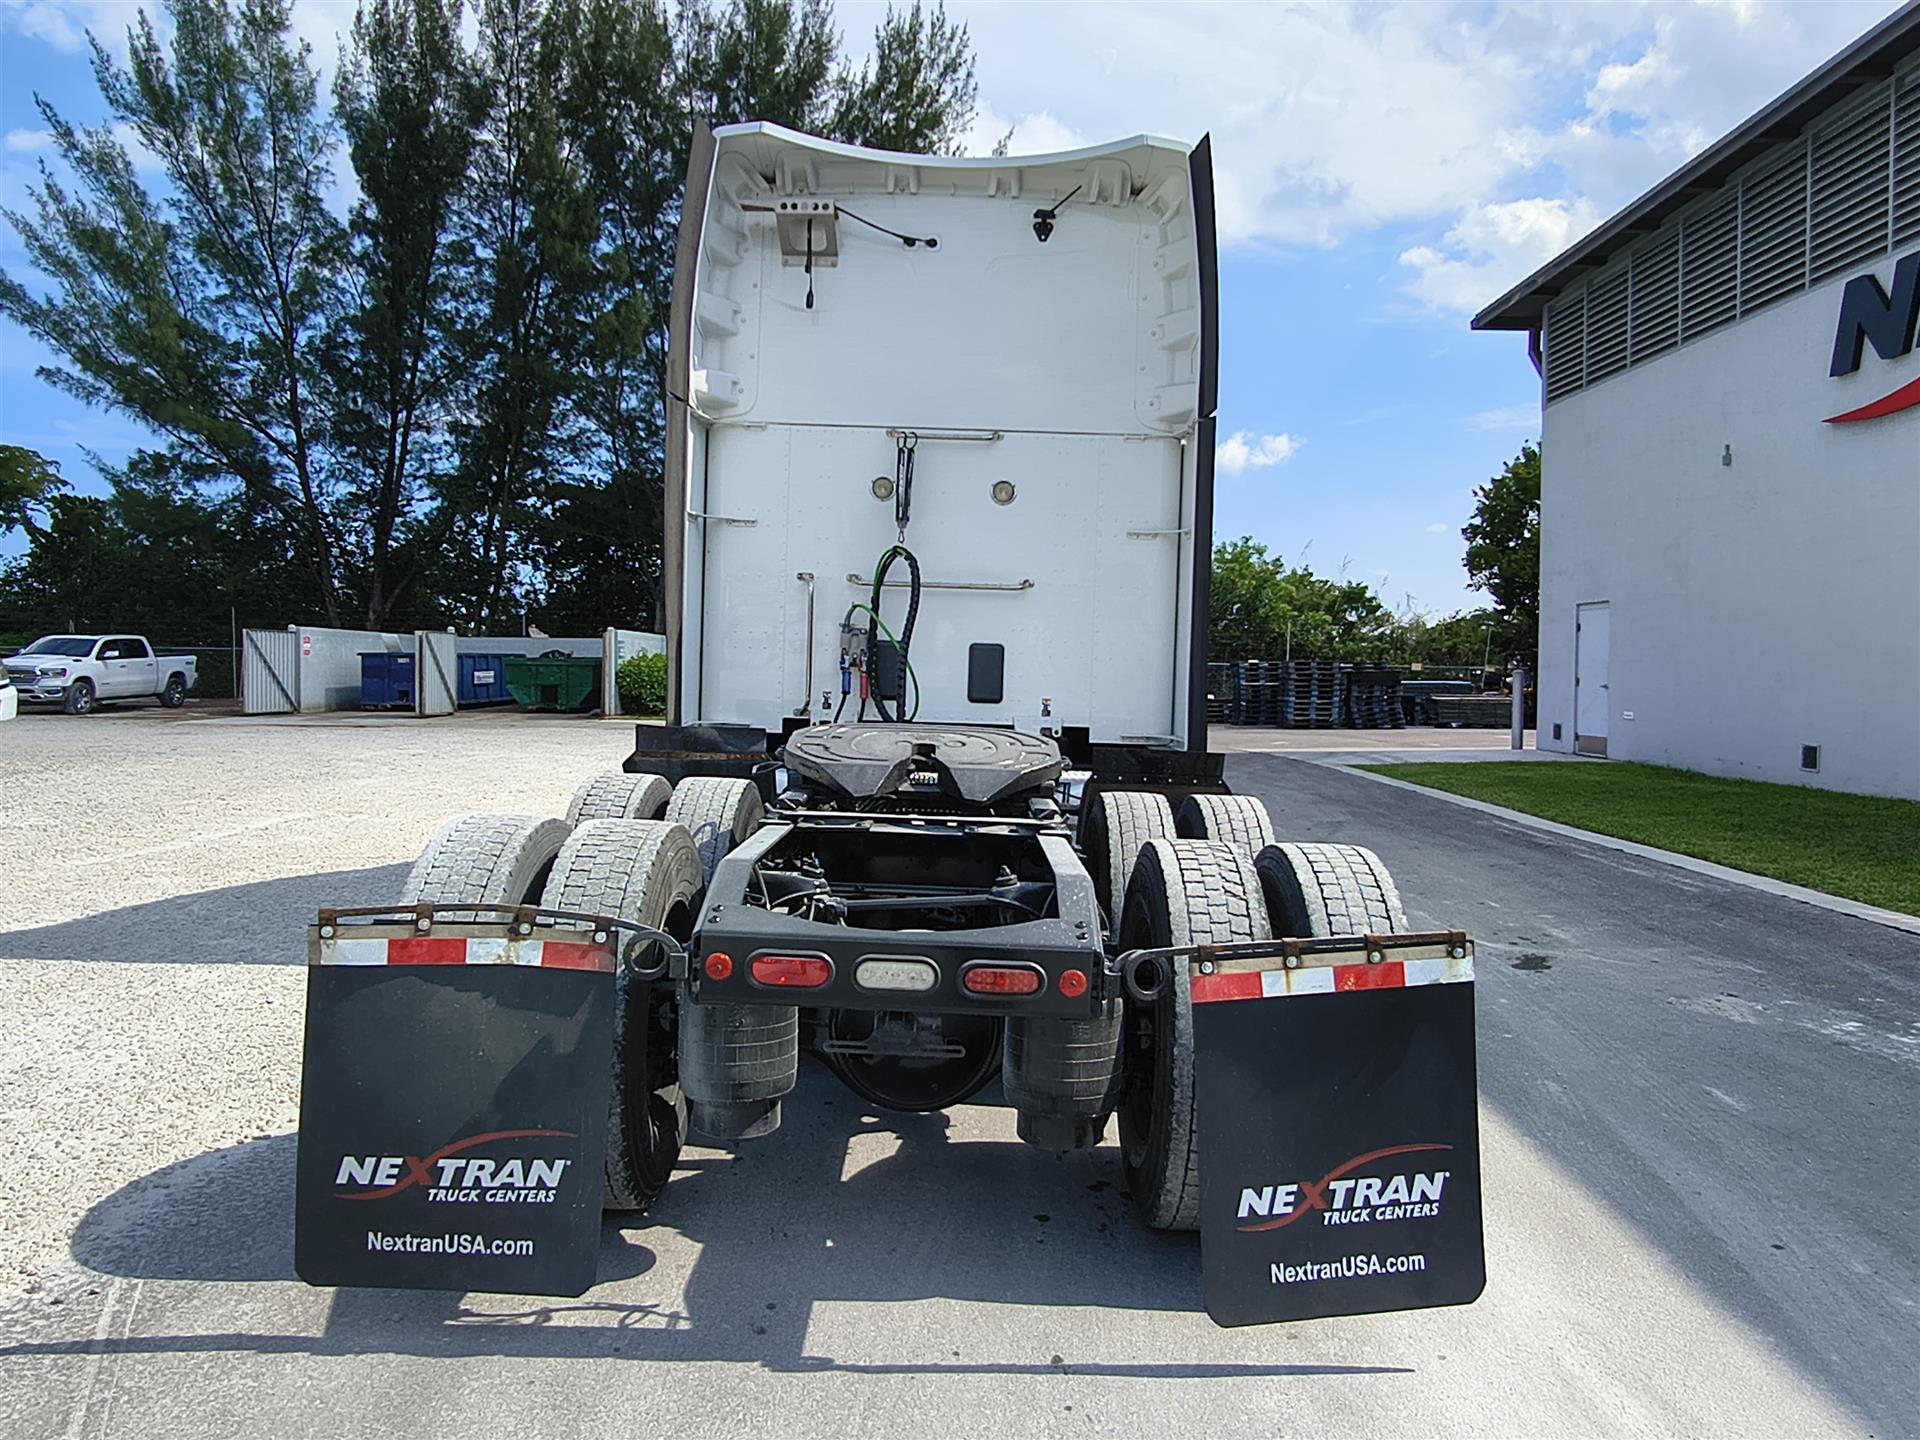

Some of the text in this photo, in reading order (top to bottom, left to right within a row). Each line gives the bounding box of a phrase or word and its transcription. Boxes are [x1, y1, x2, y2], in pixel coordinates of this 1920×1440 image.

[1829, 250, 1920, 377] N
[335, 1156, 566, 1188] NEXTRAN
[427, 1188, 556, 1203] TRUCK CENTERS
[1237, 1171, 1445, 1218] NEXTRAN
[1322, 1202, 1439, 1225] TRUCK CENTERS
[367, 1231, 534, 1255] NextranUSA.com
[1270, 1253, 1426, 1284] NextranUSA.com
